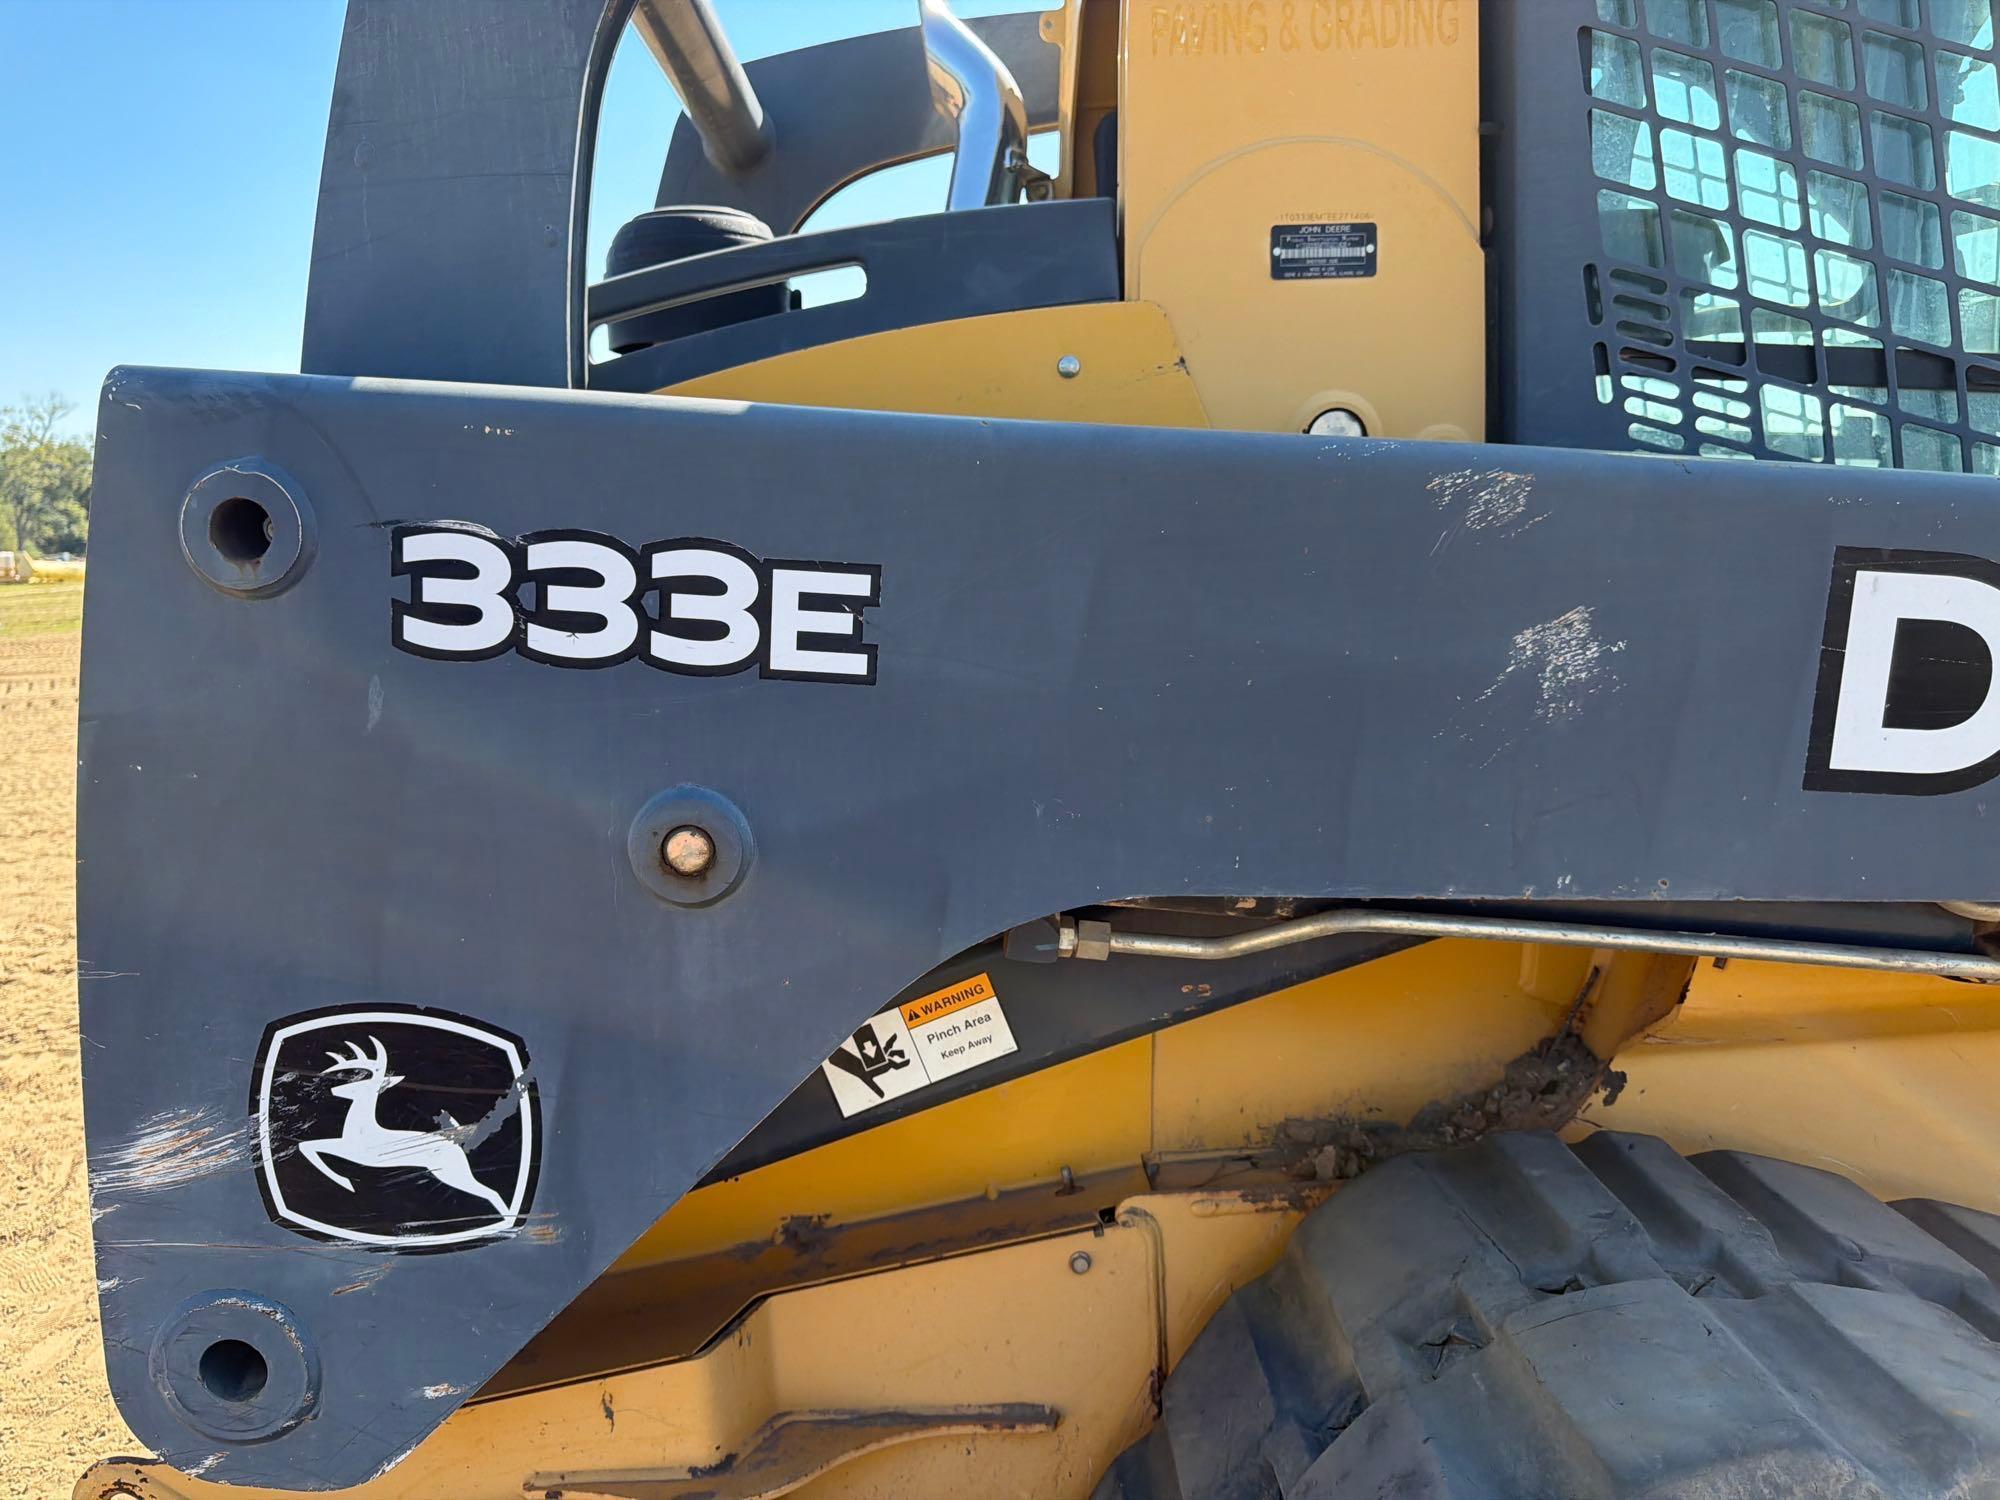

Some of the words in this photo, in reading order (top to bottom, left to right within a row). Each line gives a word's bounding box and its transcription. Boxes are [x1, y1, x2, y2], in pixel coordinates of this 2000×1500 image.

[1151, 1, 1269, 56] PAVING
[1280, 0, 1301, 51] &
[1311, 0, 1461, 48] GRADING
[1298, 225, 1322, 234] JOHN
[1325, 224, 1351, 233] DEERE
[400, 530, 873, 677] 333E
[920, 983, 985, 1016] WARNING
[926, 1024, 962, 1044] Pinch
[964, 1012, 991, 1030] Area
[940, 1046, 966, 1060] Keep
[967, 1035, 992, 1049] Away
